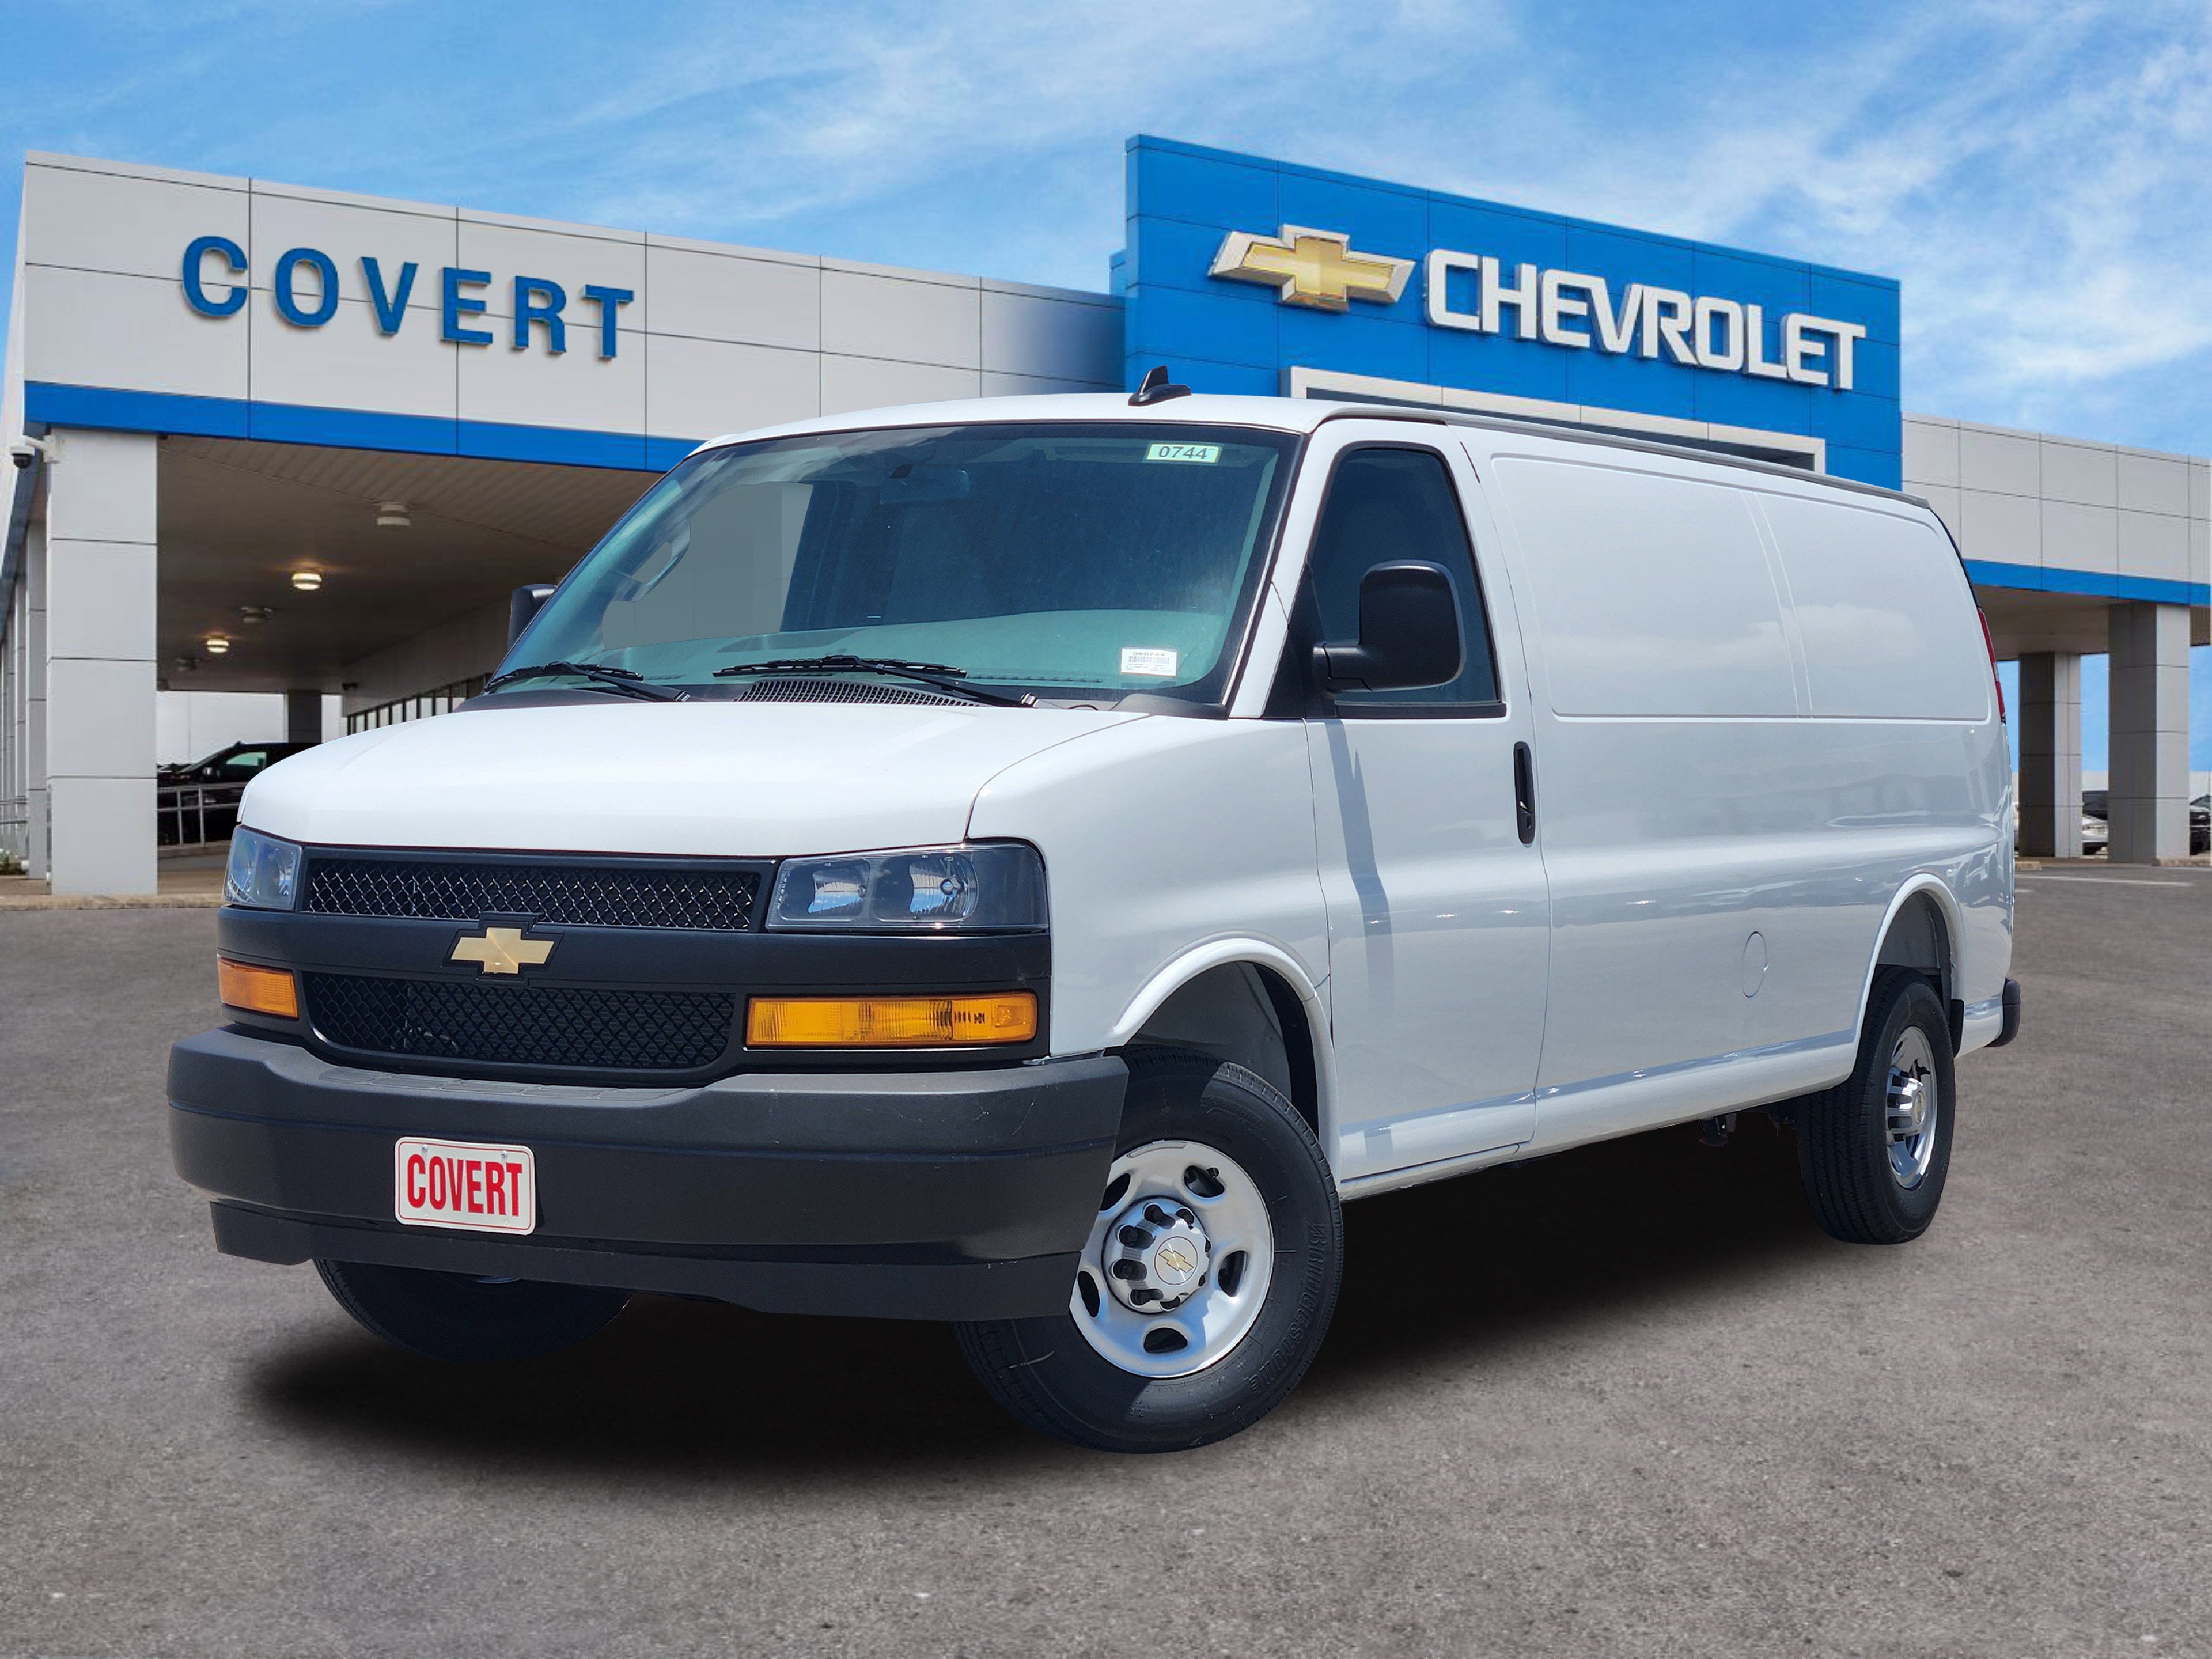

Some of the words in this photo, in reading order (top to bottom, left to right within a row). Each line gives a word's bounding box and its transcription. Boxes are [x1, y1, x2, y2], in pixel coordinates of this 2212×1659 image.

[182, 236, 634, 360] COVERT
[1426, 249, 1866, 391] CHEVROLET
[1158, 446, 1207, 460] 0744
[407, 1154, 522, 1217] COVERT
[1249, 1217, 1328, 1395] BRIDGESTONE
